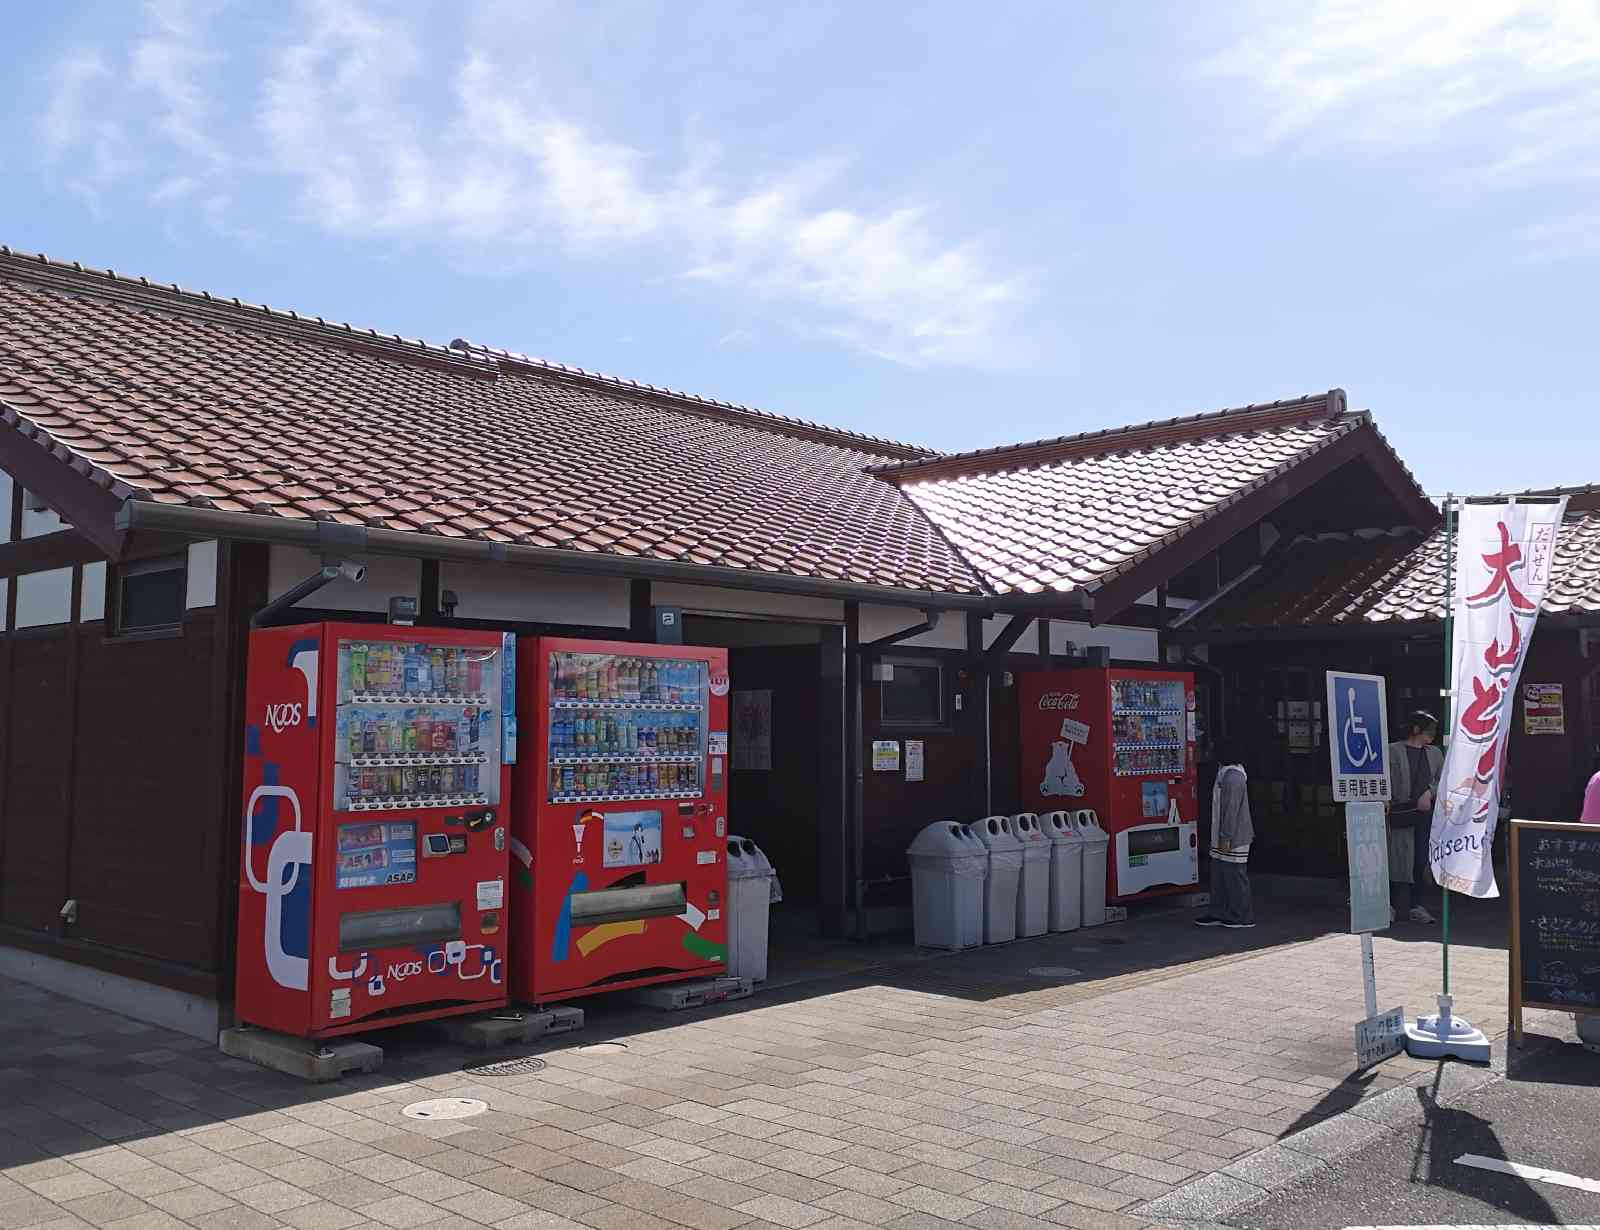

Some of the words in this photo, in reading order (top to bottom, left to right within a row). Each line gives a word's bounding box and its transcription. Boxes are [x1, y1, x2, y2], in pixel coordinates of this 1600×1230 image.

[1532, 527, 1550, 581] だいせん
[1337, 778, 1388, 797] 専用駐車場
